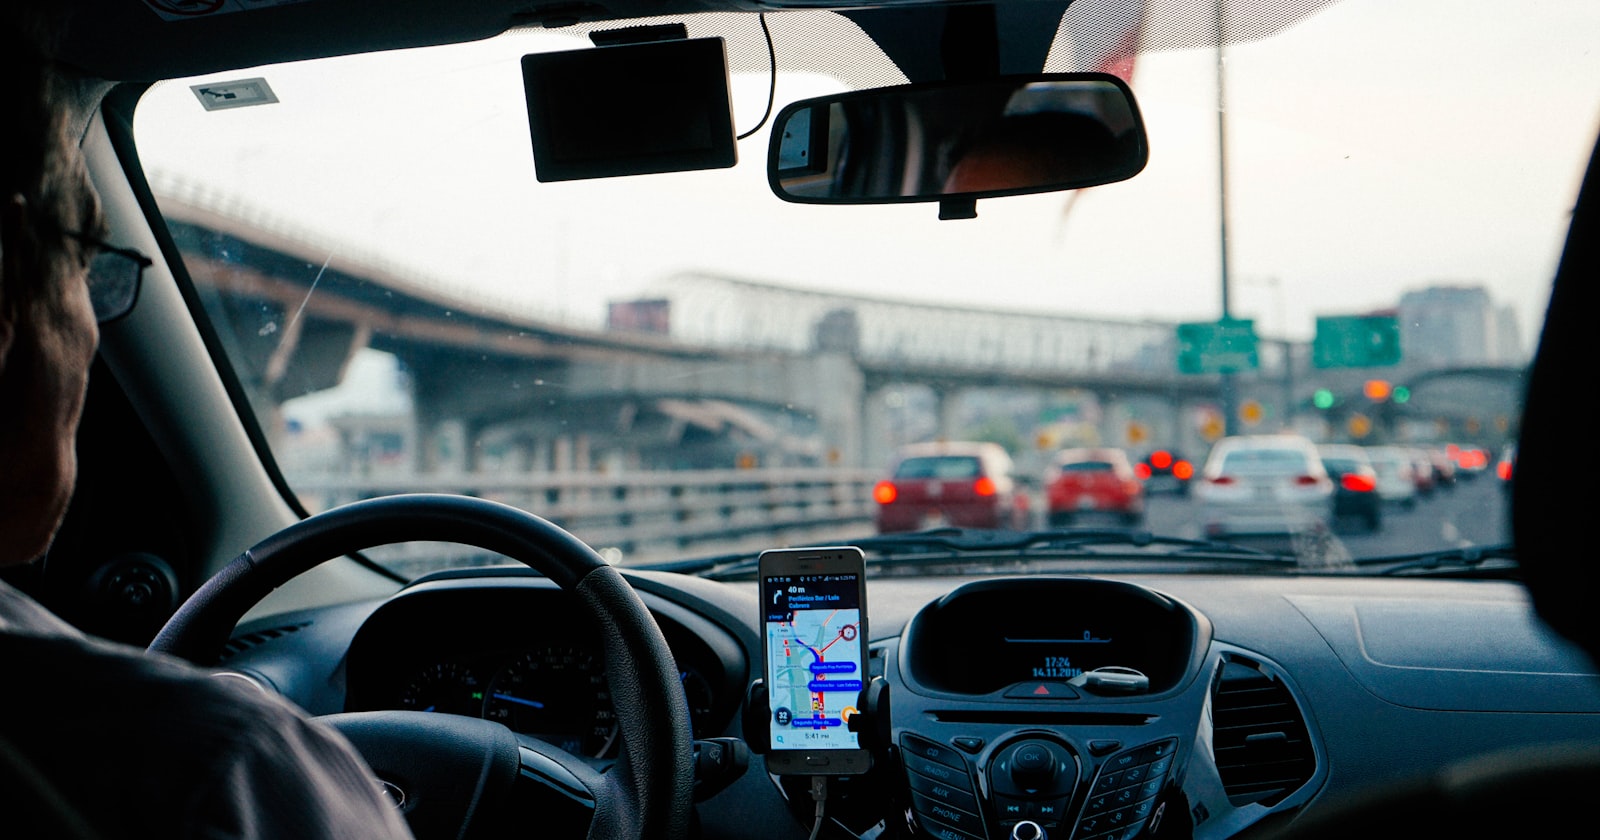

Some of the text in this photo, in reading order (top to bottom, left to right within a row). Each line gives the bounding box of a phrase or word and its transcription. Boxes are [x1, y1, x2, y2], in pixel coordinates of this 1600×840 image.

[1045, 657, 1070, 667] 17:24
[1033, 668, 1082, 678] 14.11.2016
[927, 748, 938, 757] CD
[924, 766, 950, 778] RADIO
[932, 786, 949, 797] AUX
[932, 806, 960, 822] PHONE
